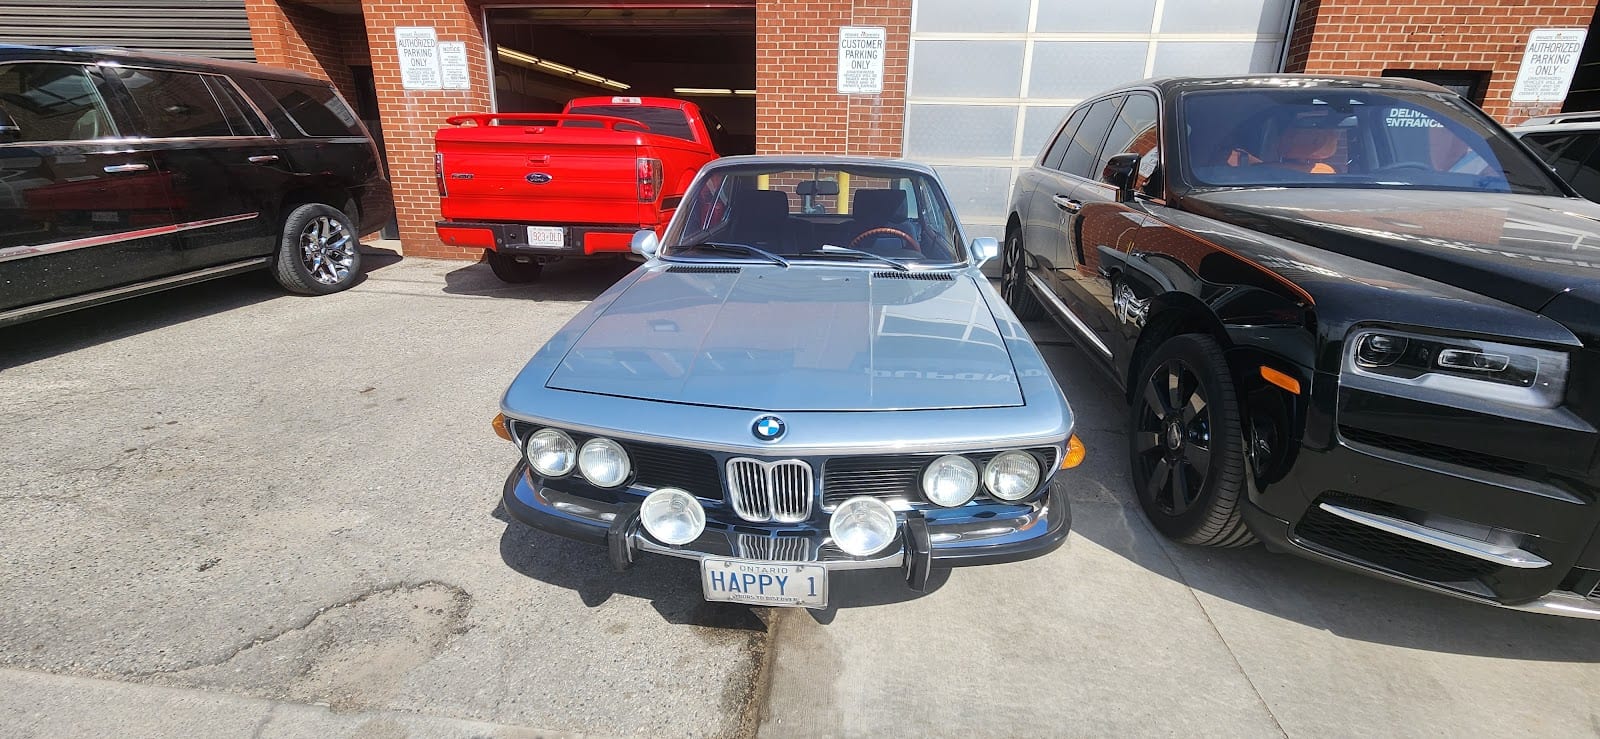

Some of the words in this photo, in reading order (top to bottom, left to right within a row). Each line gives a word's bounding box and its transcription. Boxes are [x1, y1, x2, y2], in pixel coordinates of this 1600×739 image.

[399, 39, 436, 48] AUTHORIZED
[841, 39, 883, 49] CUSTOMER
[1528, 42, 1581, 53] AUTHORIZED
[403, 49, 433, 57] PARKING
[845, 50, 878, 59] PARKING
[410, 58, 427, 67] ONLY
[1530, 54, 1571, 65] PARKING
[851, 60, 871, 69] ONLY
[1535, 65, 1559, 76] ONLY
[739, 565, 789, 574] ONTARIO
[711, 570, 788, 596] HAPPY
[807, 576, 817, 597] 1
